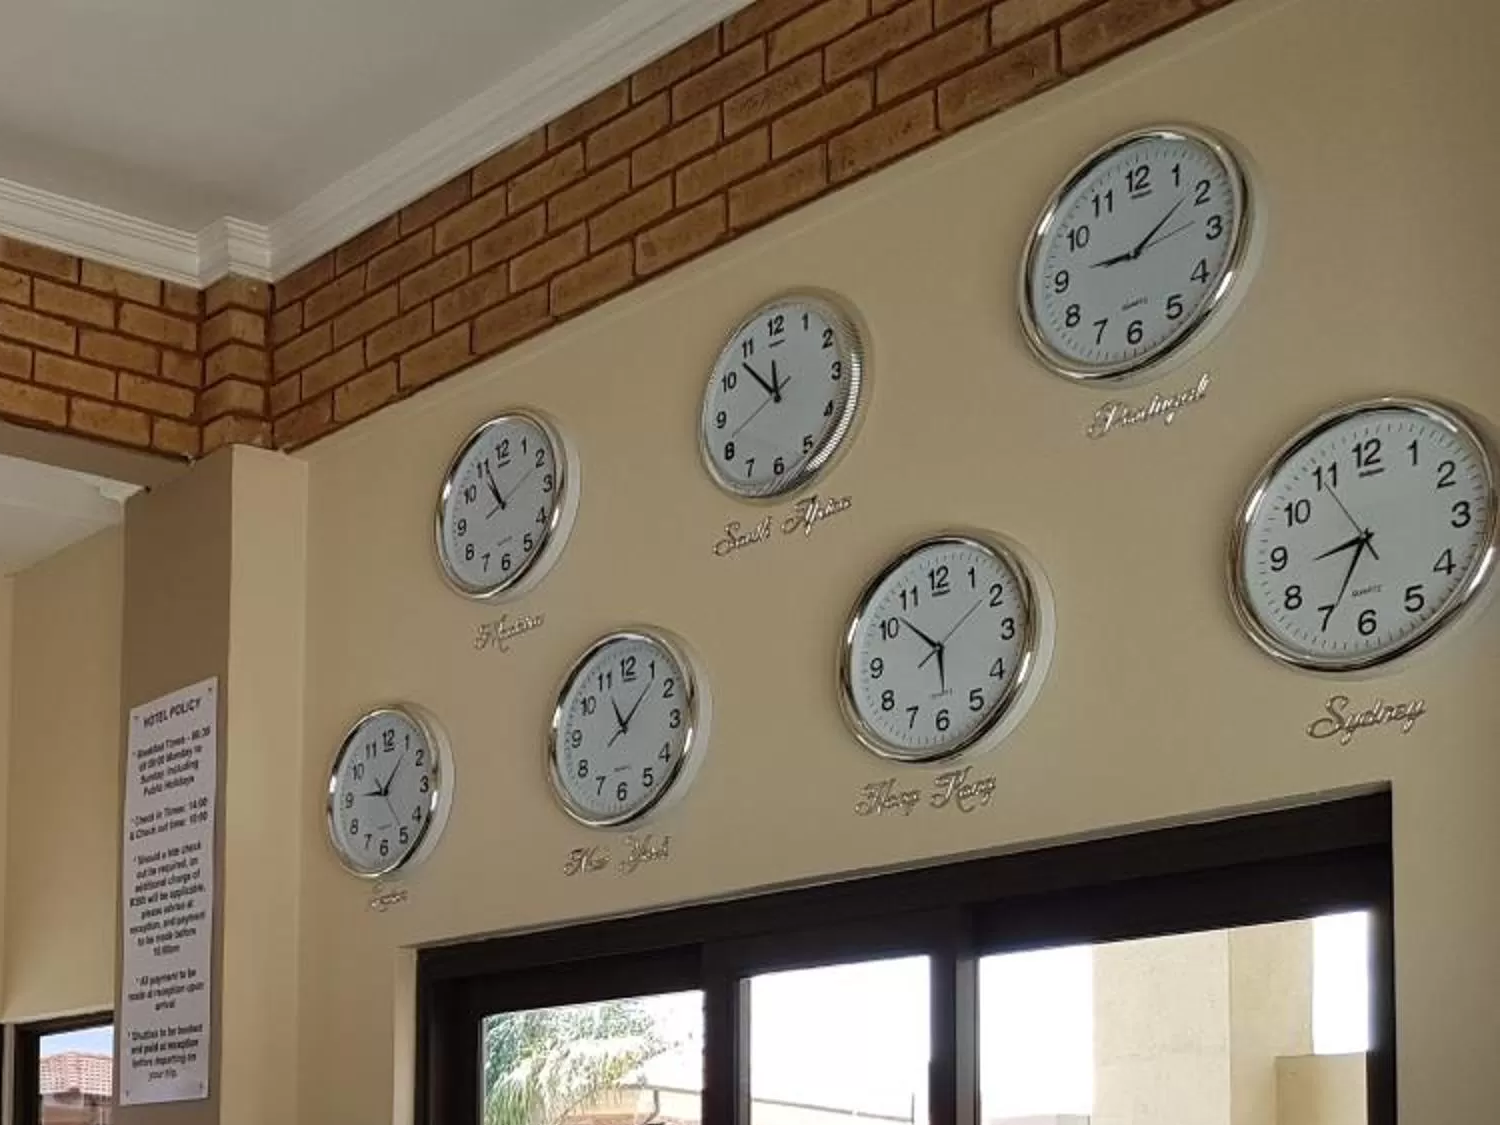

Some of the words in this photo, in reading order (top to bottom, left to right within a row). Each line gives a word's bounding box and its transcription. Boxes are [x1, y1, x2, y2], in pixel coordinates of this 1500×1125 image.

[1125, 164, 1150, 193] 12
[1171, 164, 1181, 187] 1
[1194, 180, 1210, 206] 2
[1092, 190, 1113, 218] 11
[1206, 215, 1222, 240] 3
[1066, 226, 1089, 251] 10
[1190, 259, 1210, 283] 4
[1054, 270, 1069, 293] 9
[1066, 304, 1080, 328] 8
[1165, 294, 1183, 319] 5
[768, 315, 784, 336] 12
[802, 313, 808, 330] 1
[1094, 319, 1108, 344] 7
[822, 328, 833, 349] 2
[1127, 320, 1143, 344] 6
[743, 339, 754, 358] 11
[831, 362, 841, 380] 3
[722, 372, 737, 392] 10
[824, 400, 833, 417] 4
[717, 411, 726, 429] 9
[495, 439, 509, 459] 12
[521, 437, 527, 455] 1
[725, 442, 735, 460] 8
[803, 435, 813, 453] 5
[1352, 438, 1382, 468] 12
[1407, 439, 1419, 466] 1
[476, 458, 490, 478] 11
[536, 449, 544, 468] 2
[746, 458, 754, 477] 7
[774, 457, 784, 475] 6
[544, 474, 552, 492] 3
[1312, 462, 1338, 491] 11
[1436, 460, 1456, 488] 2
[464, 484, 476, 505] 10
[536, 507, 546, 524] 4
[780, 493, 853, 538] Africa
[1284, 499, 1311, 527] 10
[1451, 500, 1471, 528] 3
[458, 519, 467, 536] 9
[465, 544, 474, 560] 8
[524, 533, 532, 552] 5
[481, 552, 490, 572] 7
[502, 554, 510, 570] 6
[1270, 546, 1288, 572] 9
[1433, 549, 1456, 575] 4
[928, 566, 948, 590] 12
[968, 568, 975, 588] 1
[900, 586, 918, 610] 11
[989, 584, 1003, 607] 2
[1284, 585, 1303, 610] 8
[1404, 585, 1424, 612] 5
[1317, 604, 1335, 632] 7
[1358, 609, 1376, 635] 6
[879, 617, 899, 640] 10
[1001, 618, 1015, 640] 3
[621, 656, 636, 676] 12
[649, 660, 655, 678] 1
[870, 658, 883, 679] 9
[989, 658, 1005, 680] 4
[598, 672, 612, 691] 11
[662, 678, 674, 698] 2
[581, 696, 596, 716] 10
[881, 690, 895, 711] 8
[968, 688, 984, 711] 5
[144, 709, 168, 728] HOTEL
[169, 697, 202, 719] POLICY
[669, 709, 681, 729] 3
[906, 706, 919, 729] 7
[936, 709, 950, 731] 6
[1307, 695, 1426, 746] Sydney
[382, 729, 395, 747] 12
[405, 734, 410, 750] 1
[572, 730, 582, 748] 9
[365, 741, 377, 759] 11
[415, 750, 423, 766] 2
[659, 742, 670, 762] 4
[352, 763, 364, 780] 10
[578, 760, 588, 778] 8
[643, 768, 653, 787] 5
[420, 775, 429, 792] 3
[596, 776, 606, 795] 7
[617, 782, 627, 801] 6
[345, 792, 353, 808] 9
[412, 806, 421, 822] 4
[350, 818, 359, 834] 8
[399, 827, 408, 844] 5
[364, 834, 372, 848] 7
[380, 840, 389, 856] 6
